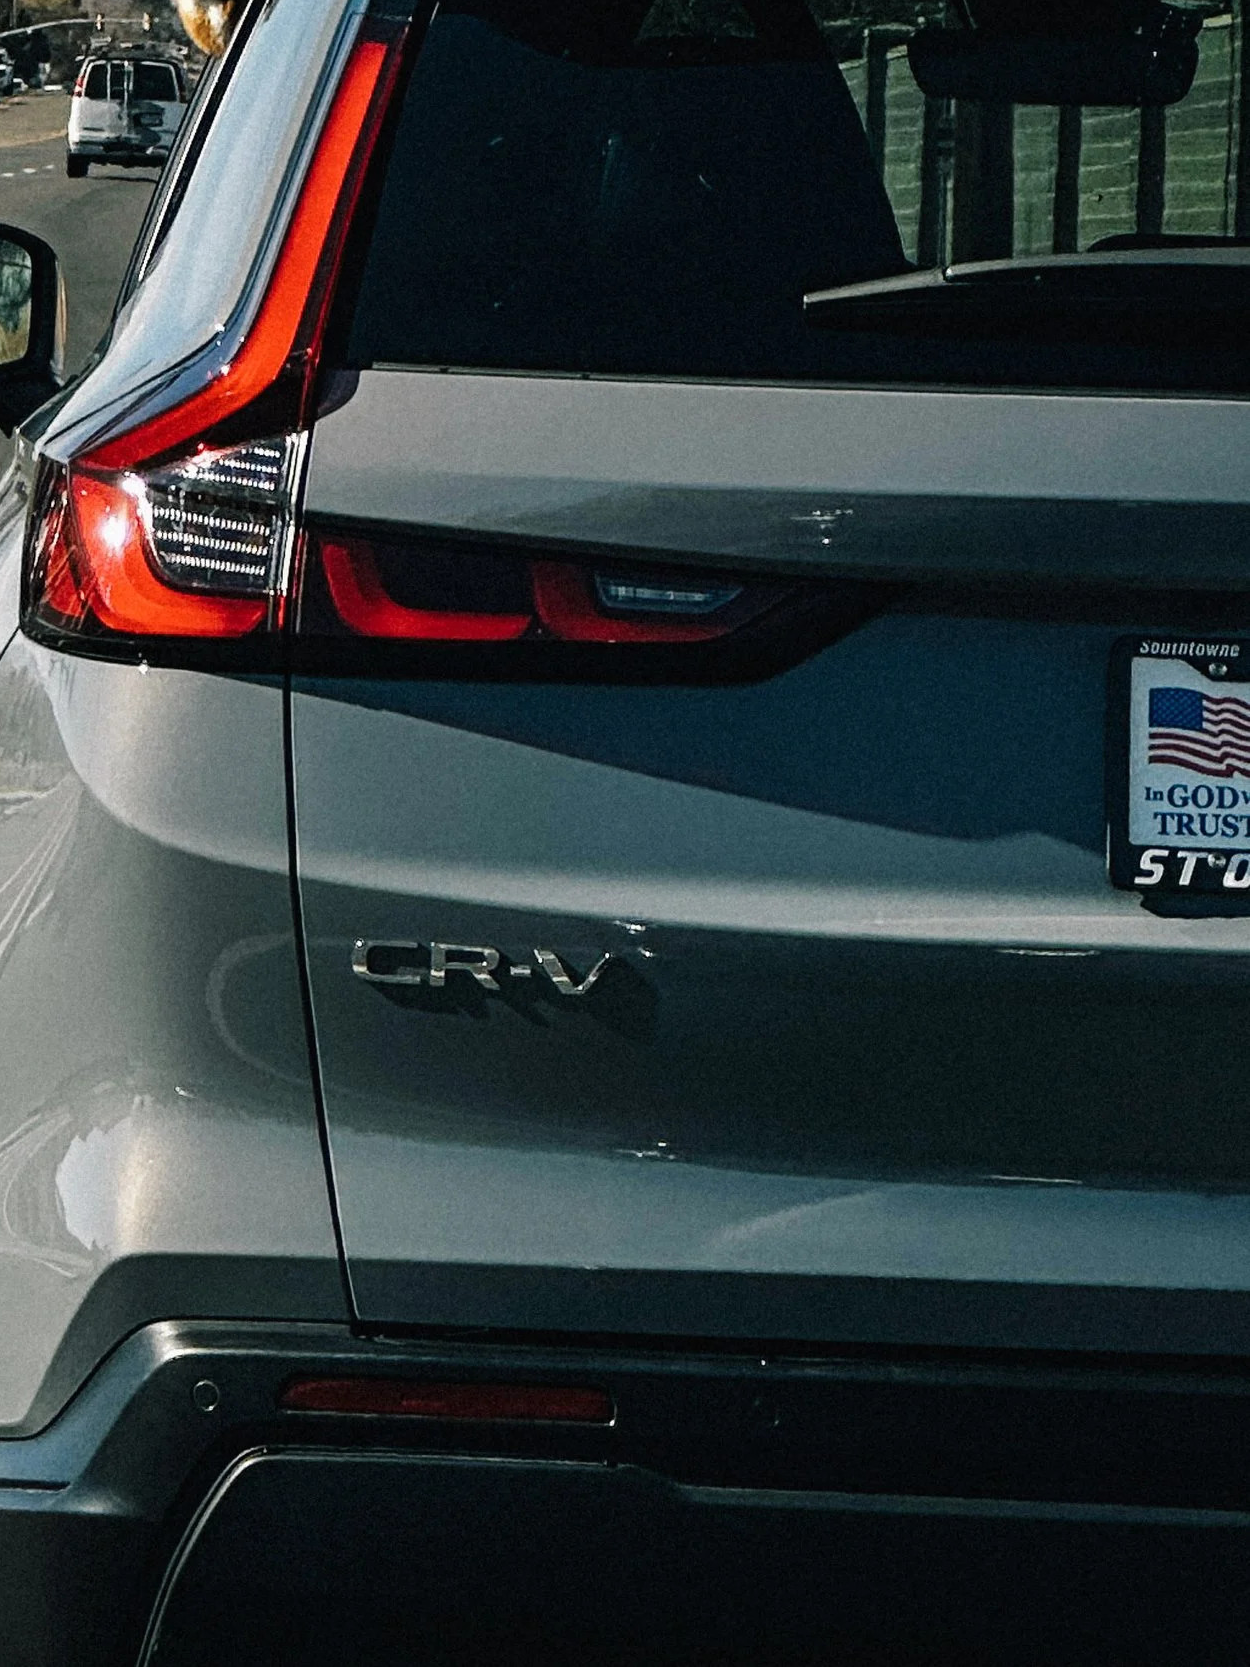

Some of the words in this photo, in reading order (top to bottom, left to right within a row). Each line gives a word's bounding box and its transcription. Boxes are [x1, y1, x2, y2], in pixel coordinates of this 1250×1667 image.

[1145, 787, 1163, 802] In
[1167, 784, 1239, 809] GOD
[351, 938, 610, 995] CR-V
